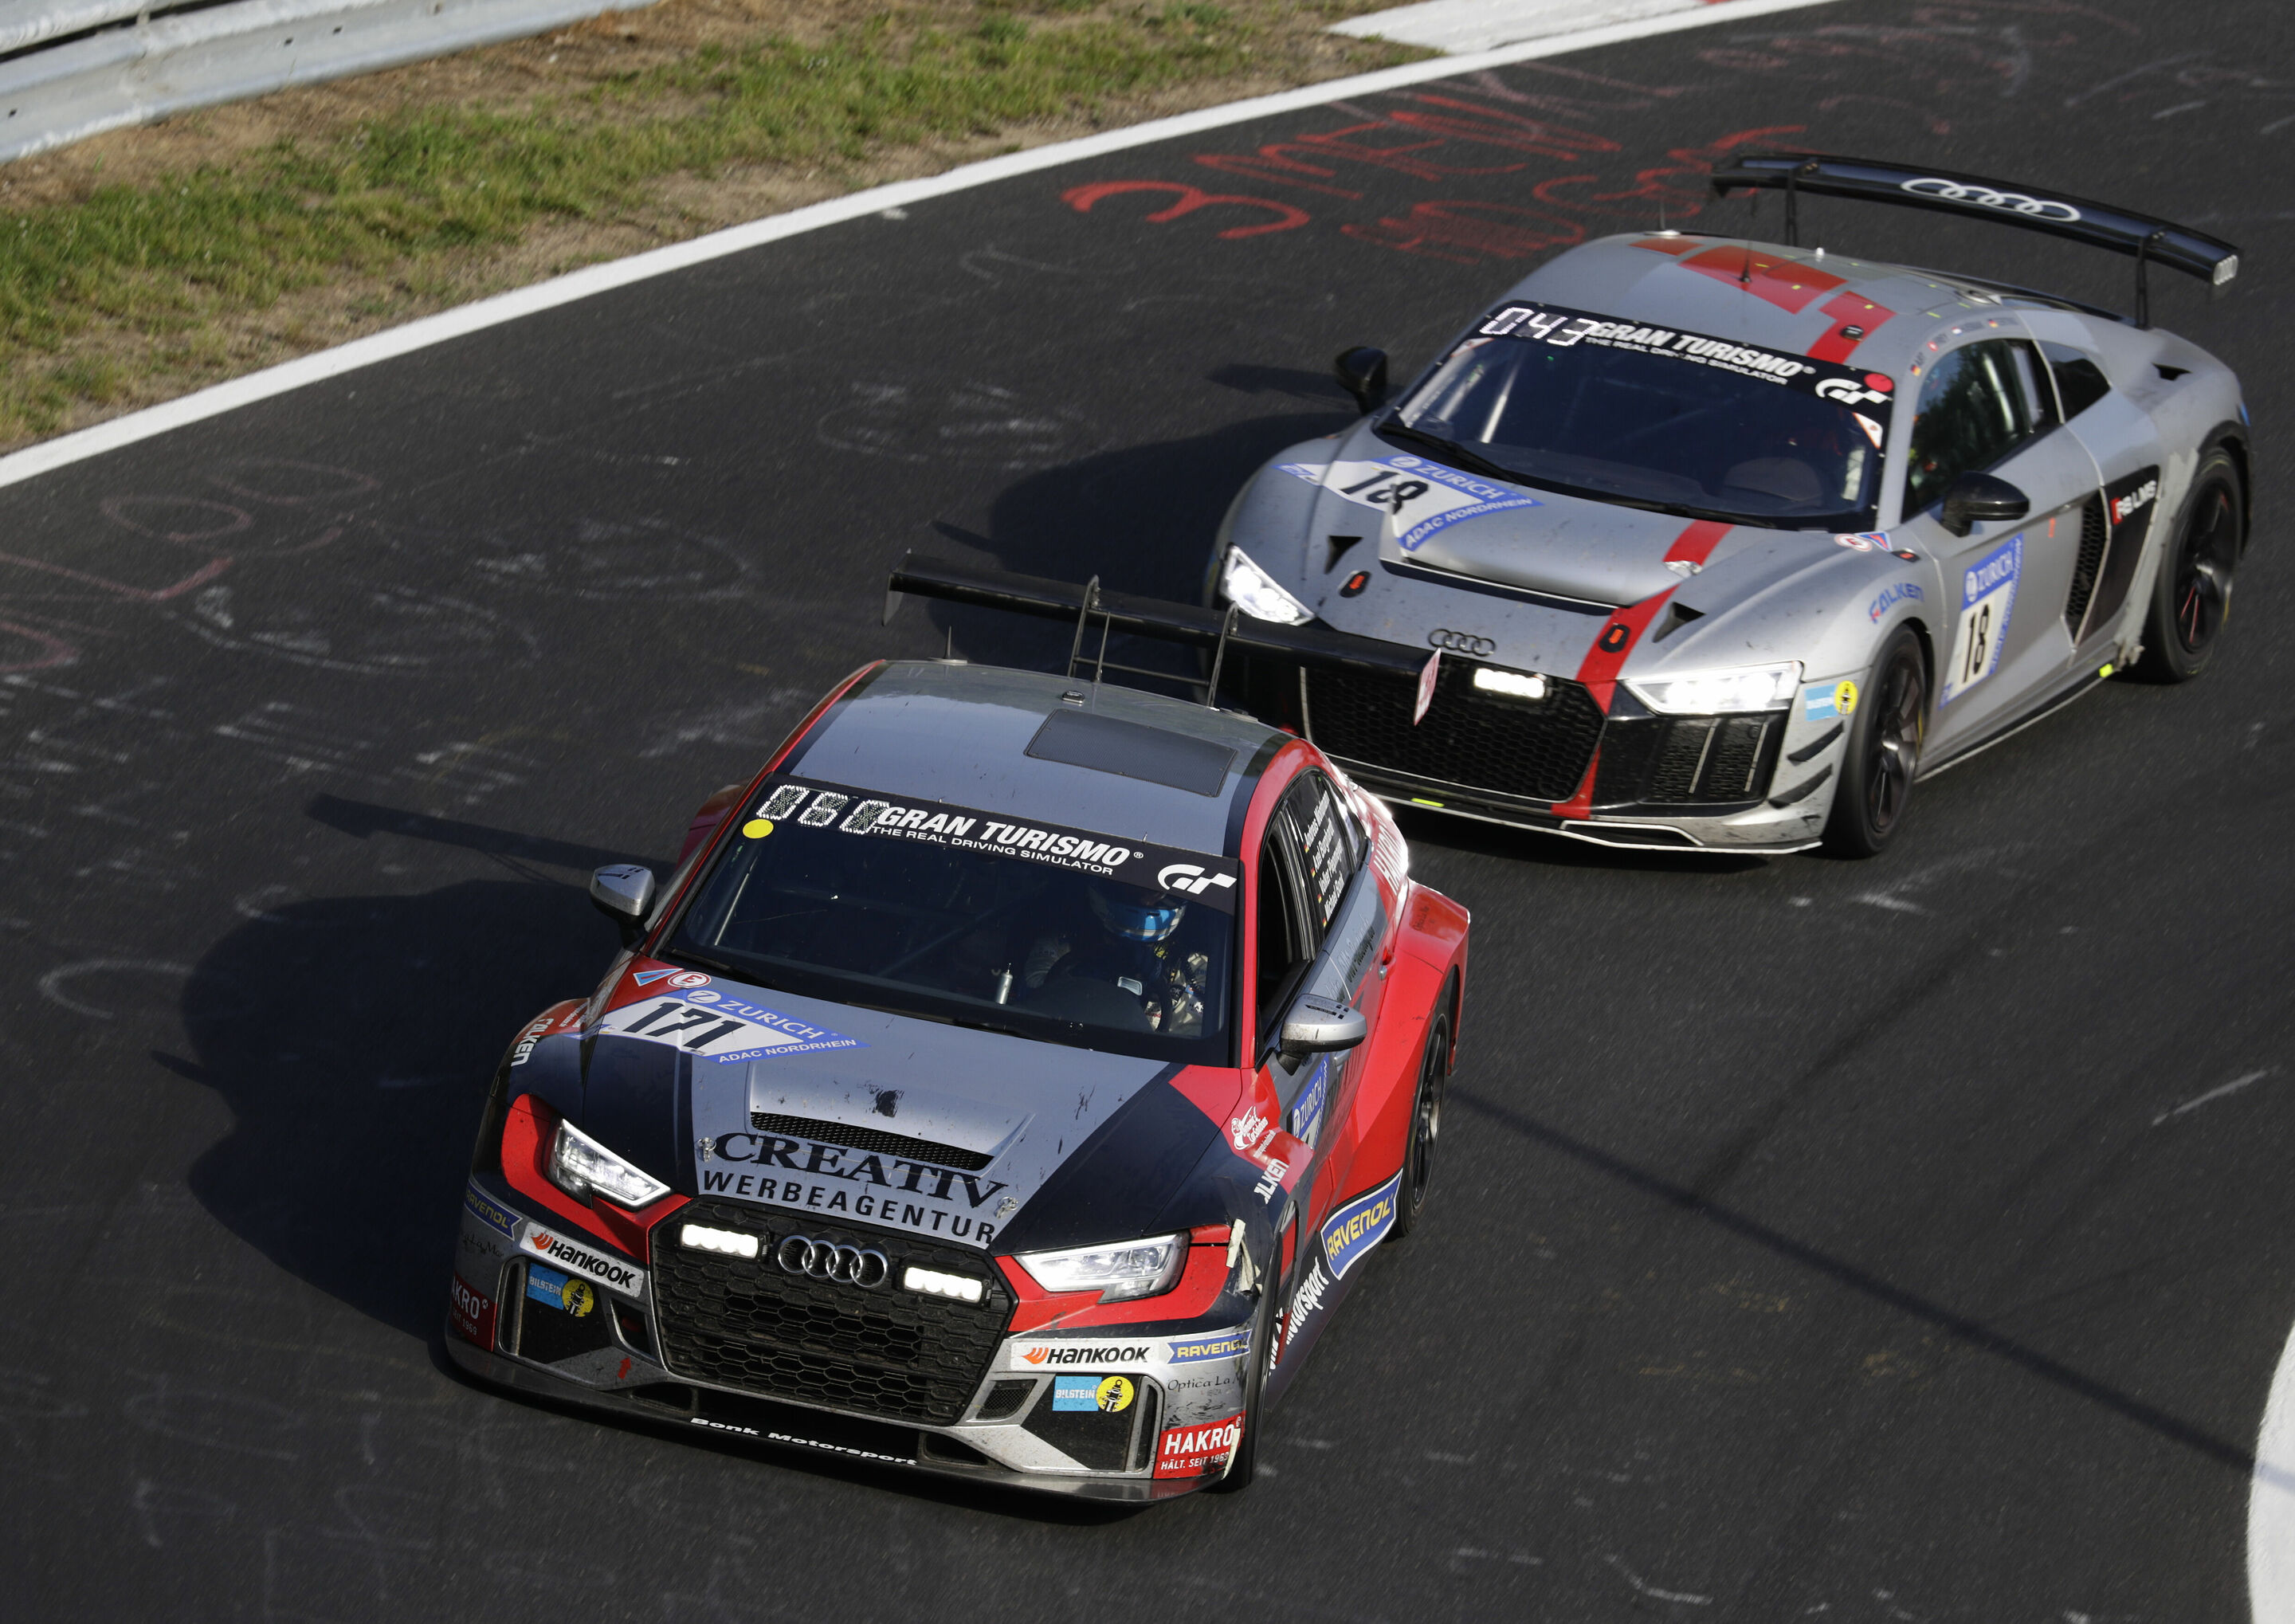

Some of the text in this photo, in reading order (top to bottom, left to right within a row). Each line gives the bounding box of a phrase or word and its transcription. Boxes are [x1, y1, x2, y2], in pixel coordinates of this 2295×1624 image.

[1480, 308, 1599, 346] 043
[1589, 322, 1675, 347] GRAN
[1585, 335, 1611, 347] THE
[1614, 340, 1647, 353] REAL
[1707, 358, 1788, 386] SIMULATOR
[1340, 472, 1429, 516] 18
[1415, 464, 1505, 500] ZURICH
[1404, 497, 1533, 548] ADAC NORDRHEIN
[1963, 602, 1989, 684] 18
[877, 806, 976, 837] GRAN
[873, 826, 1113, 876] THE REAL DRIVING SIMULATOR
[622, 1002, 746, 1049] 171
[718, 1001, 826, 1039] ZURICH
[719, 1039, 857, 1063] ADAC NORDRHEIN
[1300, 1076, 1323, 1130] ZURICH
[715, 1132, 1009, 1209] CREATIV
[466, 1188, 509, 1230] RAVENOL
[704, 1170, 996, 1245] WERBEAGENTUR
[1327, 1201, 1392, 1261] RAVENOL
[529, 1277, 563, 1296] BILSTEIN
[1055, 1388, 1096, 1399] BILSTEIN
[1167, 1379, 1211, 1393] Optica
[1214, 1375, 1230, 1387] La
[690, 1418, 917, 1465] Bonk Motorsport
[1164, 1423, 1234, 1455] HAKRO
[1160, 1458, 1186, 1470] HÄLT.
[1188, 1456, 1209, 1468] SEIT
